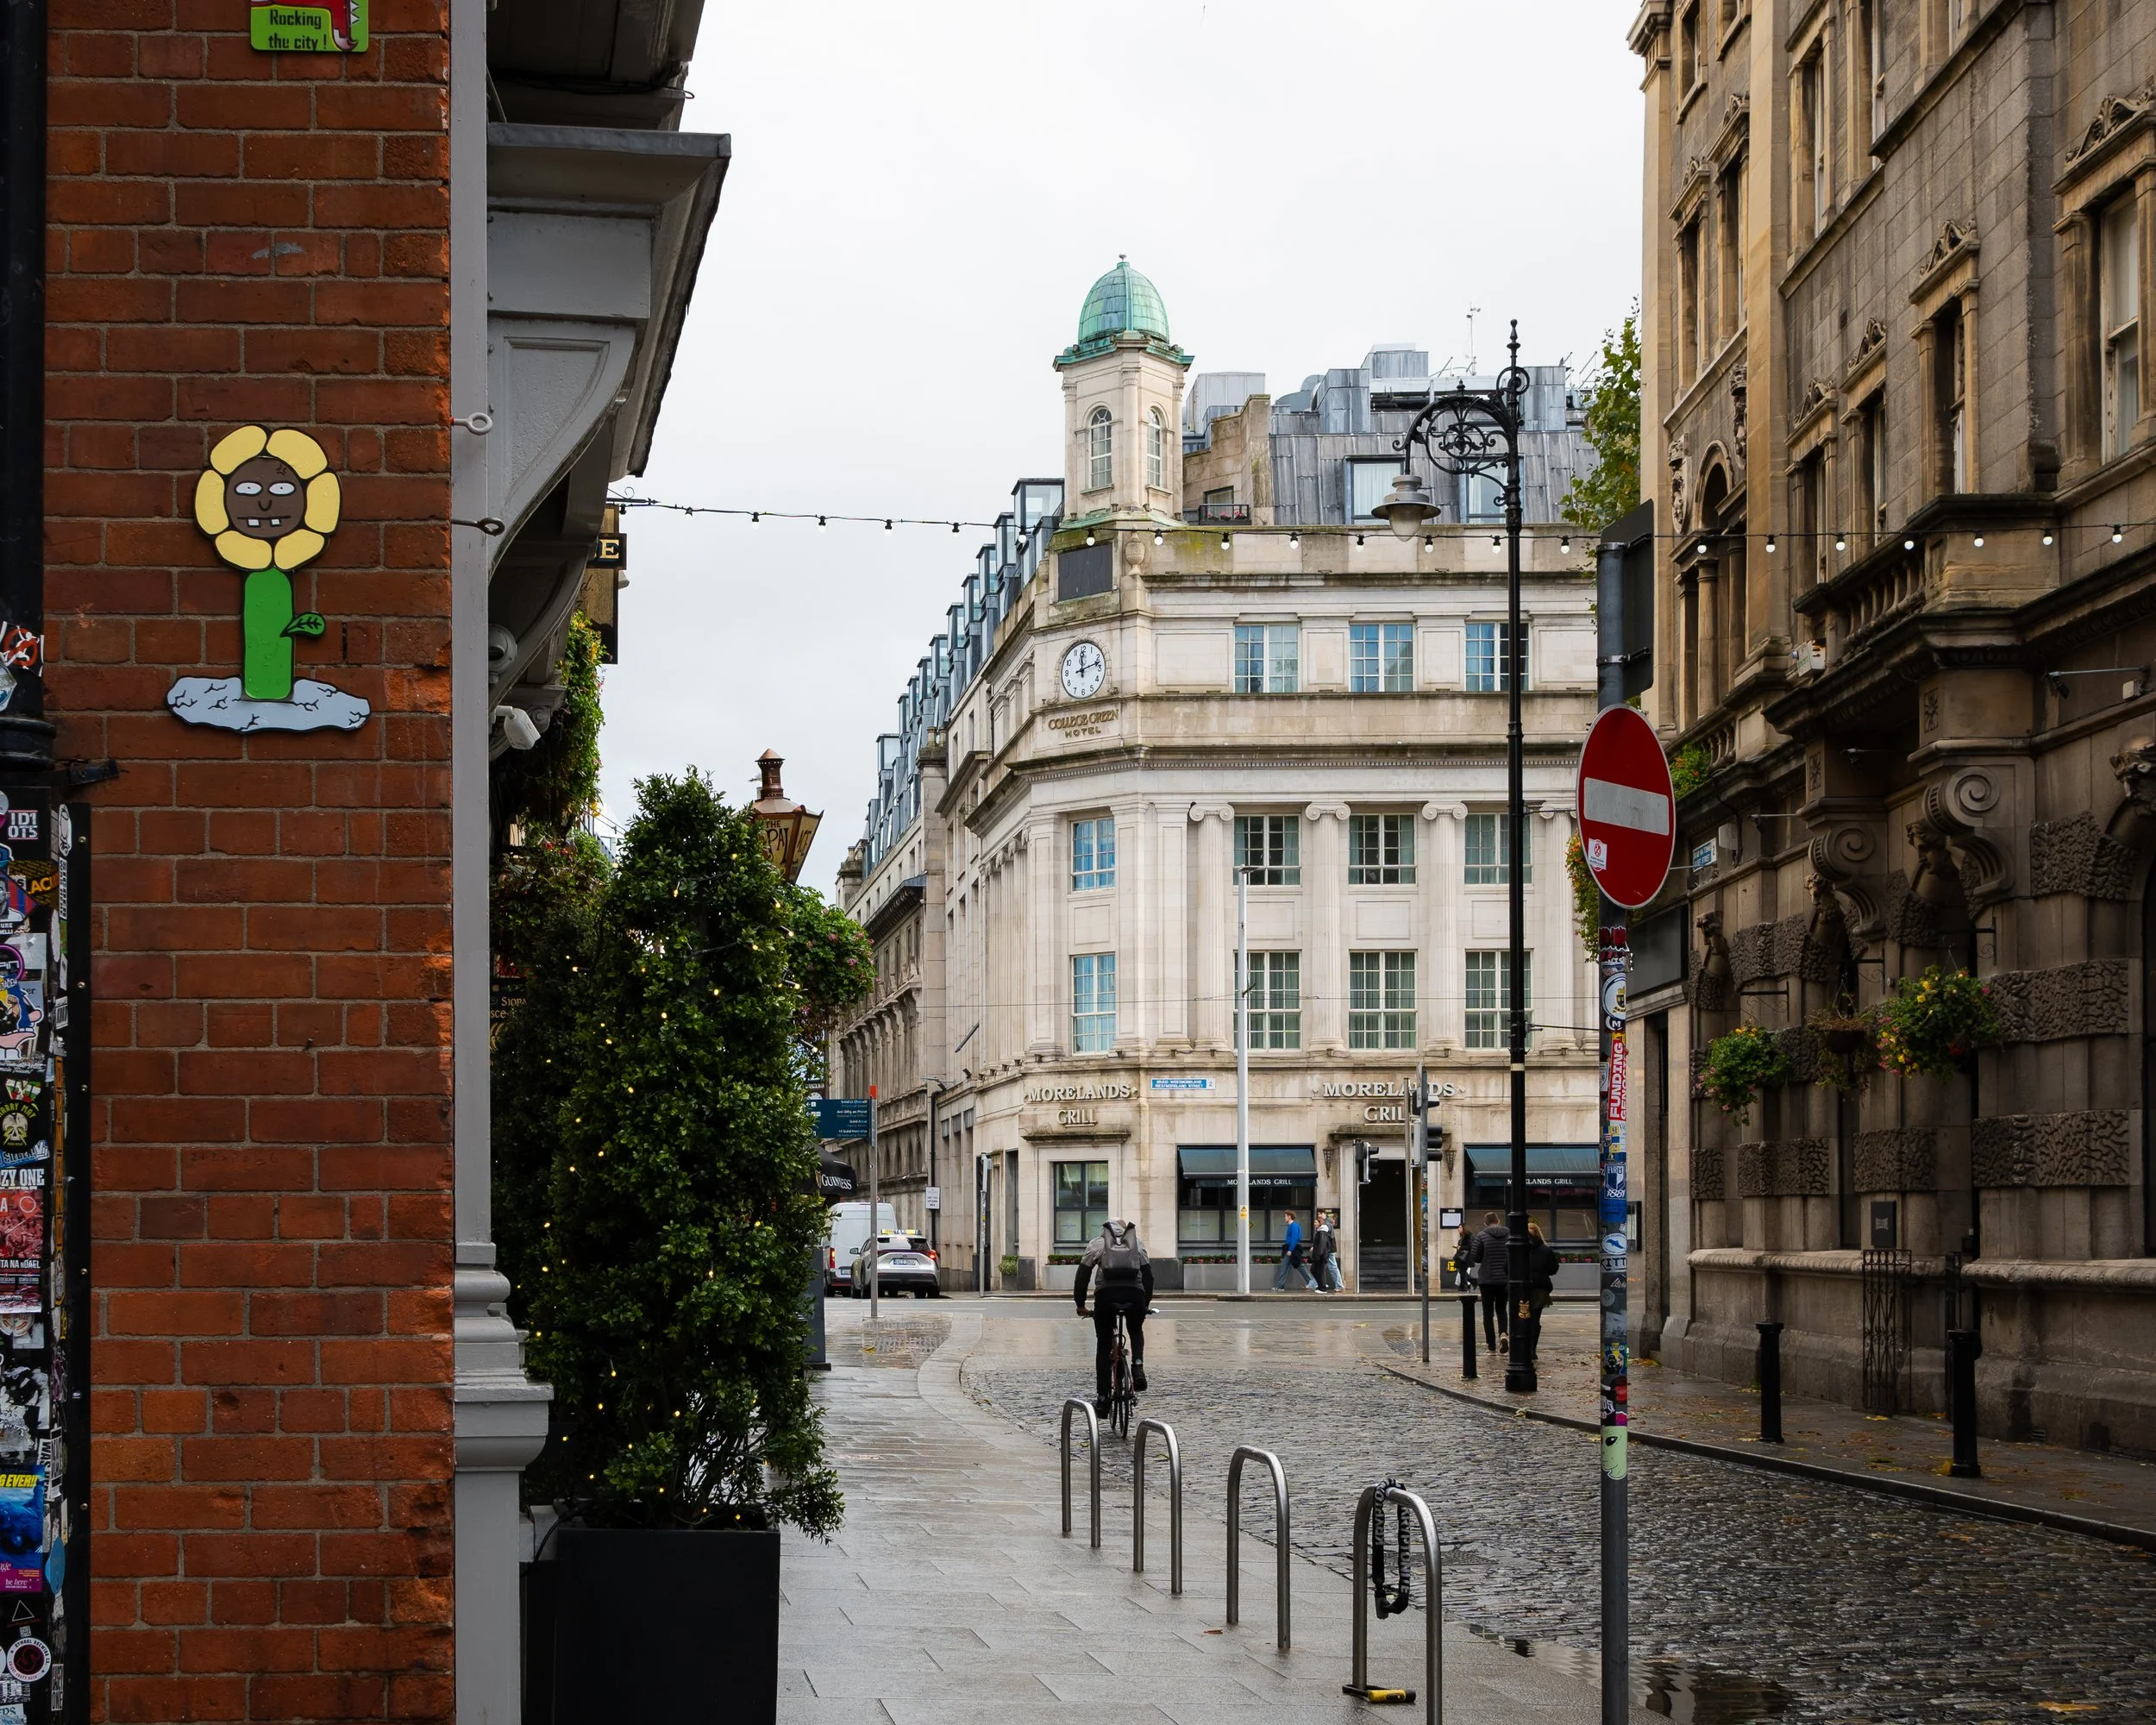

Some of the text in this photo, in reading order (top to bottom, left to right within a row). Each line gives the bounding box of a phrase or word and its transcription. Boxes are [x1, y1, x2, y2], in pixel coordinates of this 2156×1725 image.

[270, 9, 322, 29] Rocking
[269, 33, 327, 52] the city !
[1048, 709, 1119, 731] COLLEGE GREEN
[1065, 726, 1101, 738] HOTEL
[766, 819, 781, 828] THE
[1610, 1041, 1624, 1119] FUNDING
[1027, 1082, 1131, 1102] MORELANDS
[1057, 1108, 1099, 1125] GRILL
[1363, 1106, 1407, 1121] GRIL
[19, 1169, 45, 1186] ONE
[822, 1174, 852, 1189] GUINNESS
[1607, 1189, 1625, 1198] 1881
[10, 1260, 19, 1269] NA
[1400, 1505, 1411, 1594] KRYPTONITE
